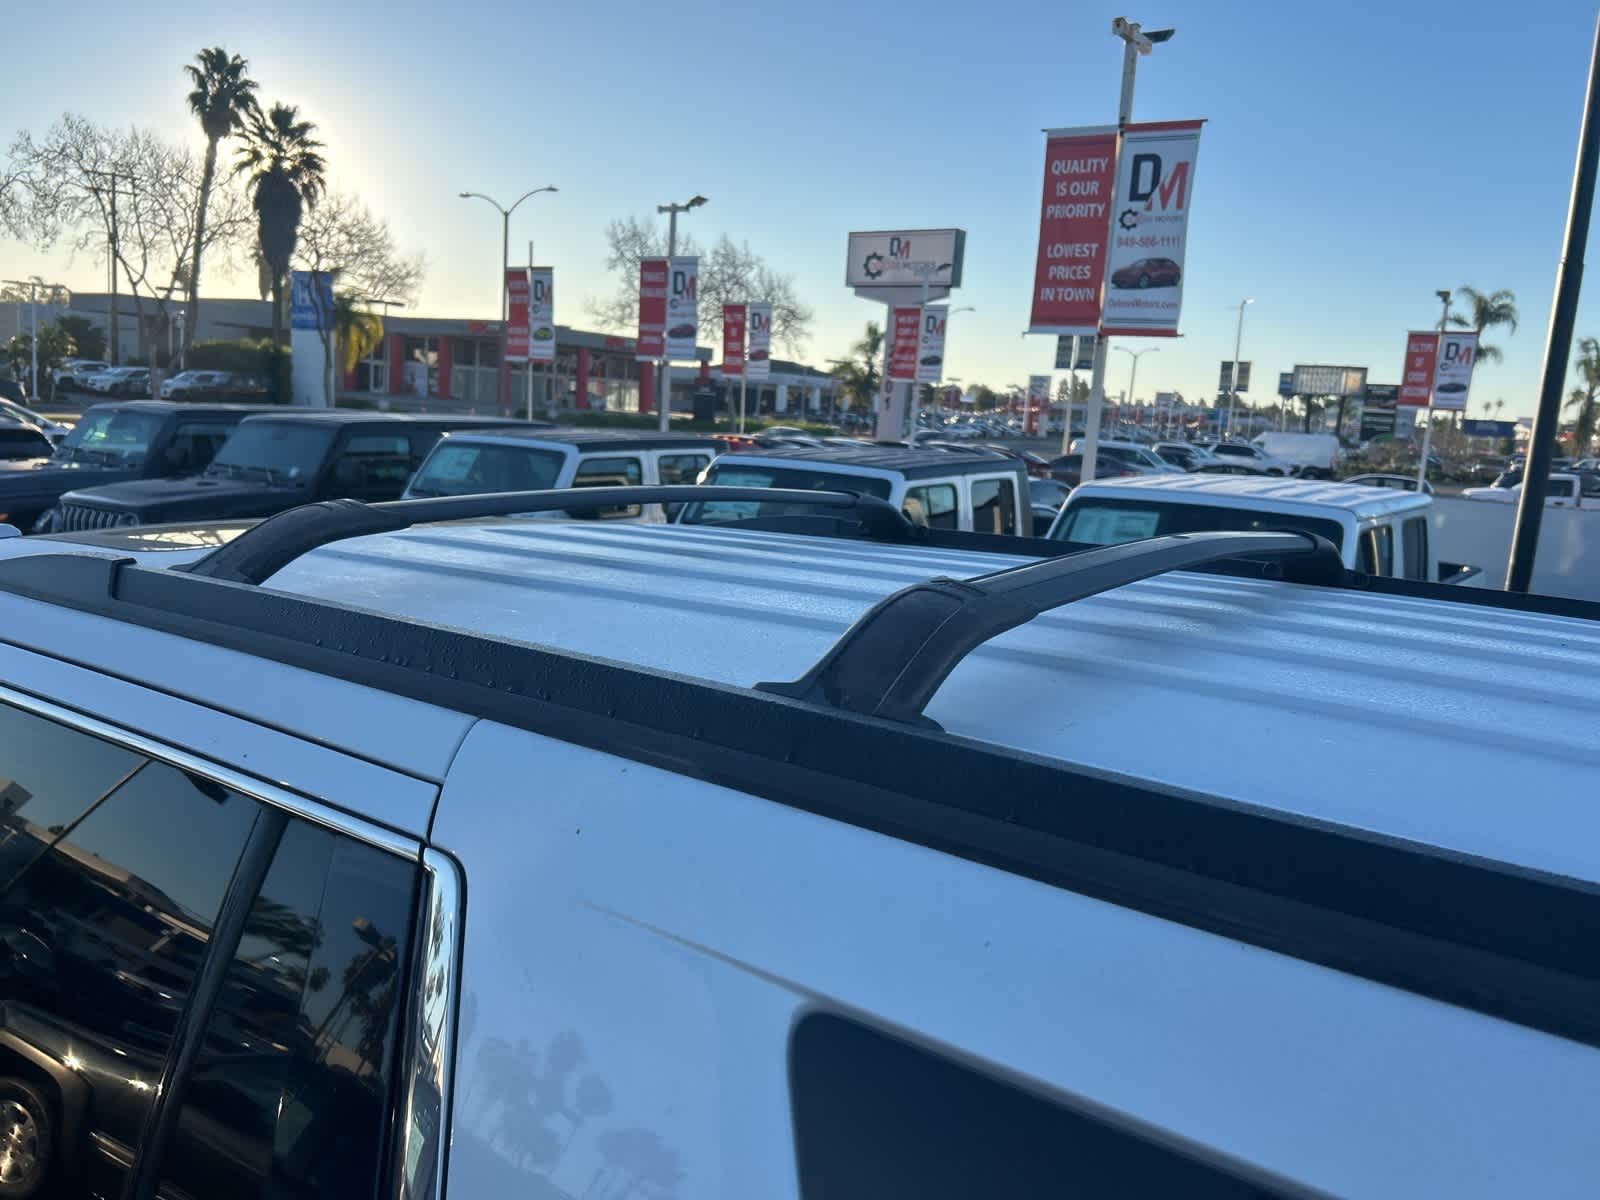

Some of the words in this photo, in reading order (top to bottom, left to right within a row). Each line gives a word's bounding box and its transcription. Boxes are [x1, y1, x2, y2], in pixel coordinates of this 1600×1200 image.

[1051, 157, 1109, 175] QUALITY
[1055, 182, 1067, 197] IS
[1069, 180, 1100, 197] OUR
[1128, 153, 1190, 211] DM
[1046, 202, 1106, 219] PRIORITY
[1047, 243, 1099, 259] LOWEST
[1048, 265, 1092, 281] PRICES
[1040, 287, 1055, 301] IN
[1056, 287, 1096, 302] TOWN
